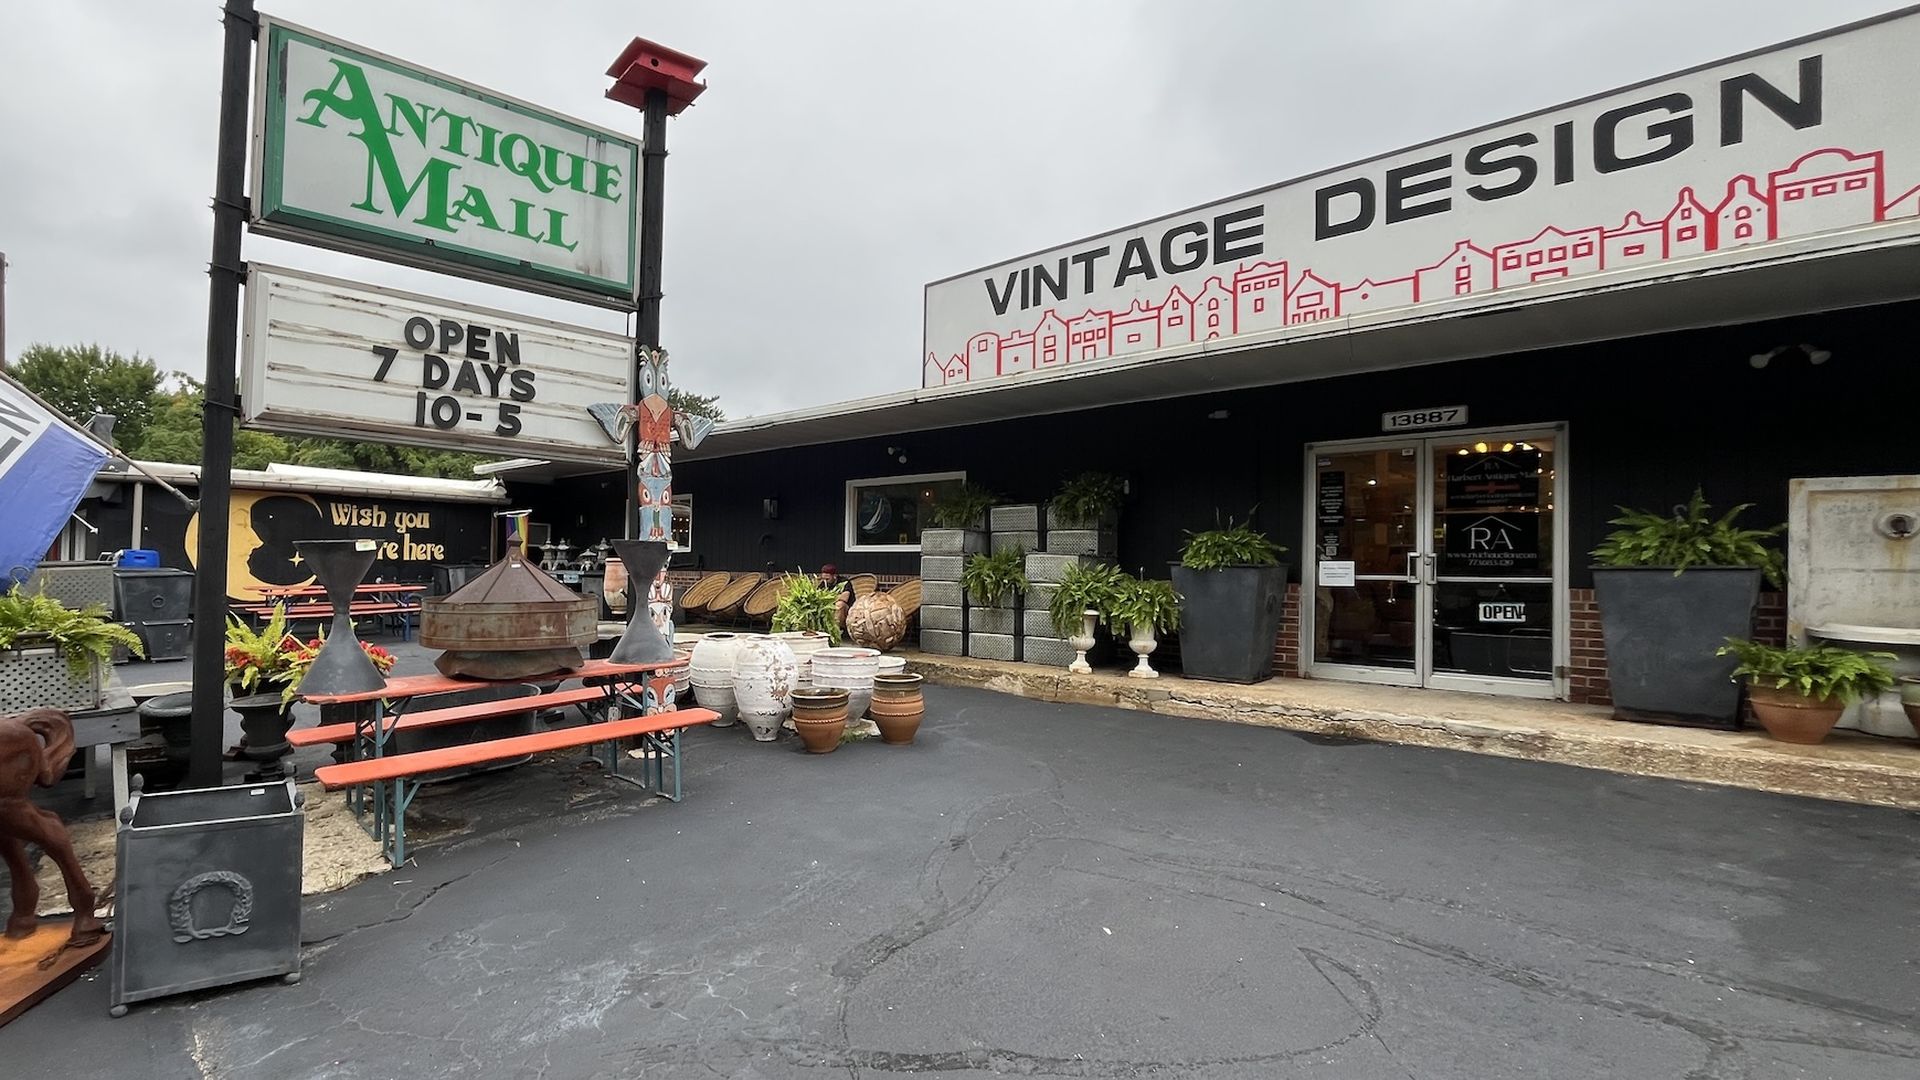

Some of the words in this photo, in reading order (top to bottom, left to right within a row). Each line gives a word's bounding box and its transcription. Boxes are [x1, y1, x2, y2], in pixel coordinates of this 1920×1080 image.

[296, 58, 623, 204] ANTIQUE
[348, 130, 579, 252] MALL
[984, 205, 1265, 317] VINTAGE
[1315, 54, 1824, 242] DESIGN
[404, 316, 521, 366] OPEN
[372, 345, 399, 382] 7
[422, 353, 536, 402] DAYS
[1390, 409, 1459, 427] 13887
[330, 502, 387, 528] Wish
[394, 511, 430, 533] you
[1471, 527, 1514, 550] RA
[403, 533, 445, 560] here
